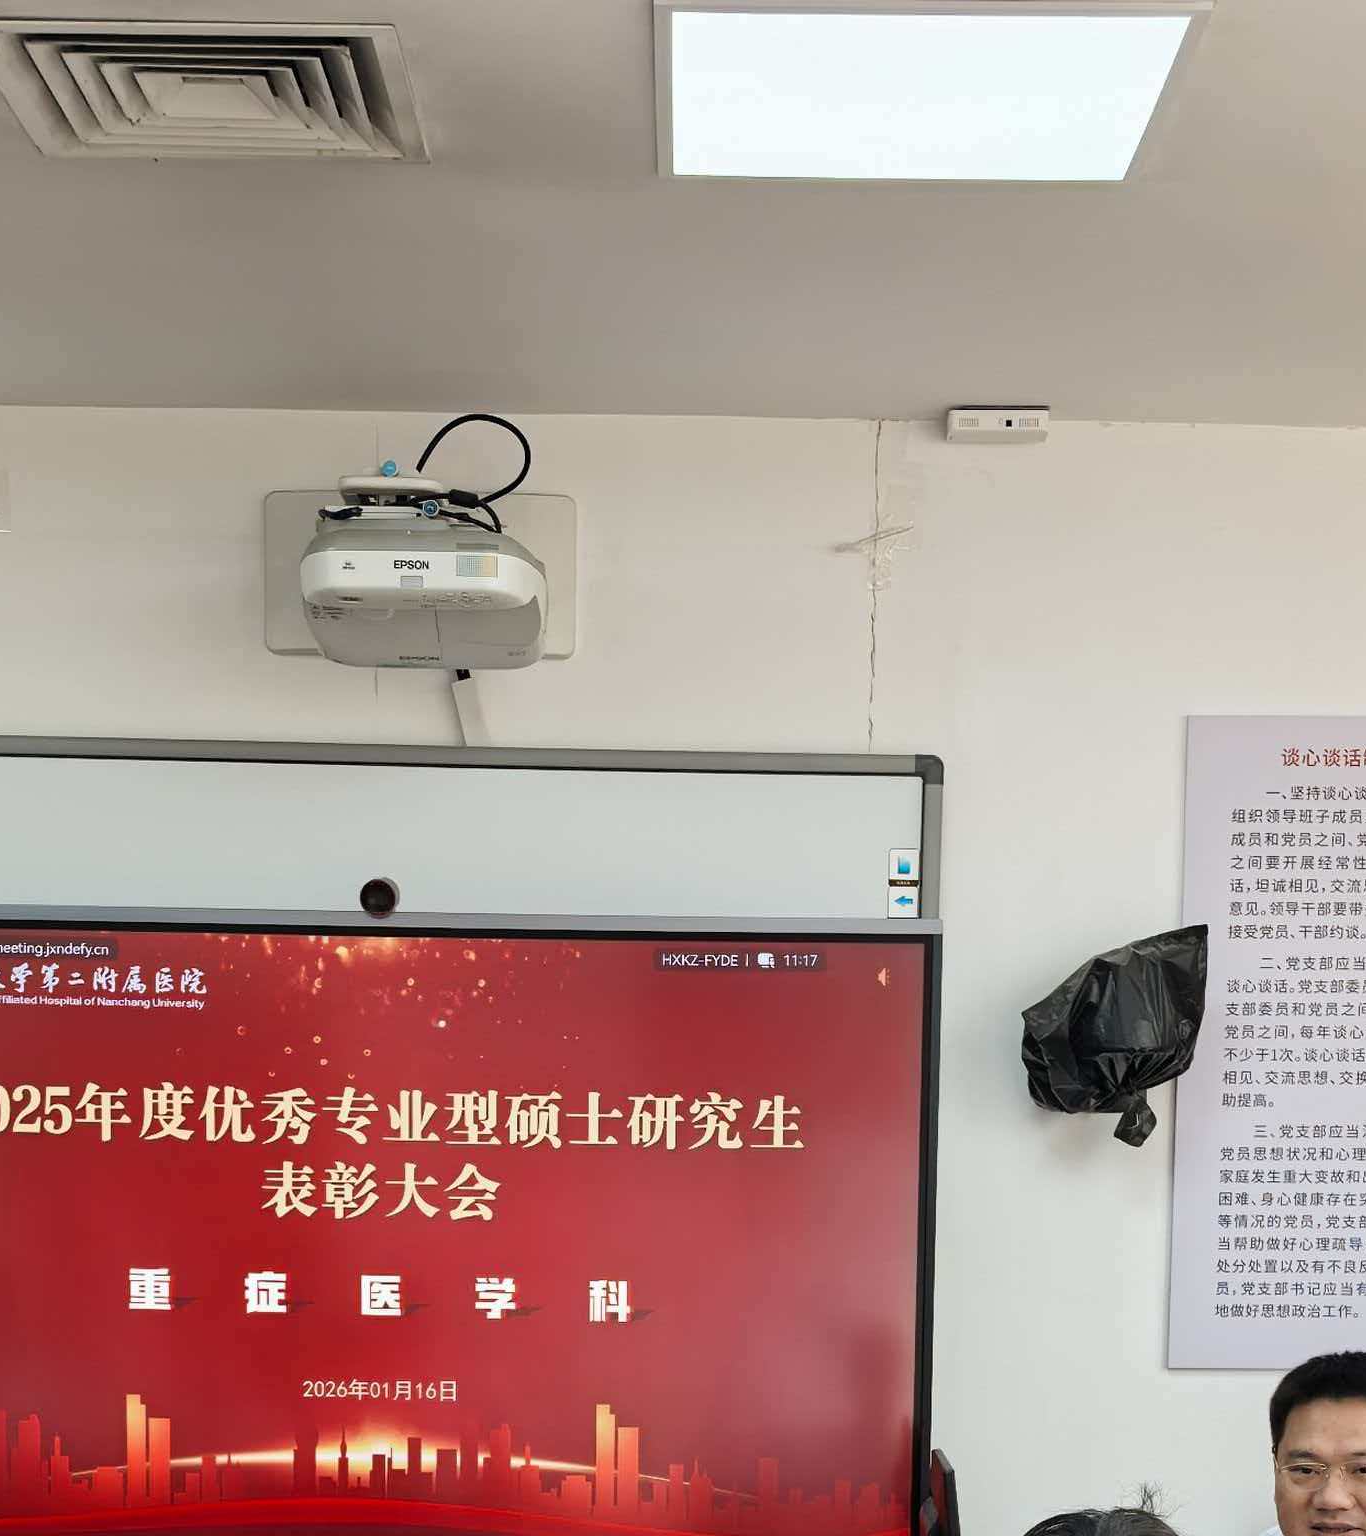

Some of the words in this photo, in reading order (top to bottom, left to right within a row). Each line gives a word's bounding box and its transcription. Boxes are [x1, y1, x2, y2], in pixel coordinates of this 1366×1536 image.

[393, 559, 430, 571] EPSON
[662, 953, 739, 967] HXKZ-FYDE
[784, 954, 819, 967] 11:17
[39, 995, 82, 1008] Hospital
[84, 996, 95, 1006] of
[97, 997, 150, 1010] Nanchang
[152, 998, 206, 1011] University
[1221, 1092, 1274, 1107] 助提高。
[262, 1160, 501, 1221] 表彰大会
[129, 1269, 631, 1322] 重症医学科
[1211, 1303, 1358, 1320] 地做好思想政治工作。
[303, 1379, 457, 1402] 2026年01月16日
